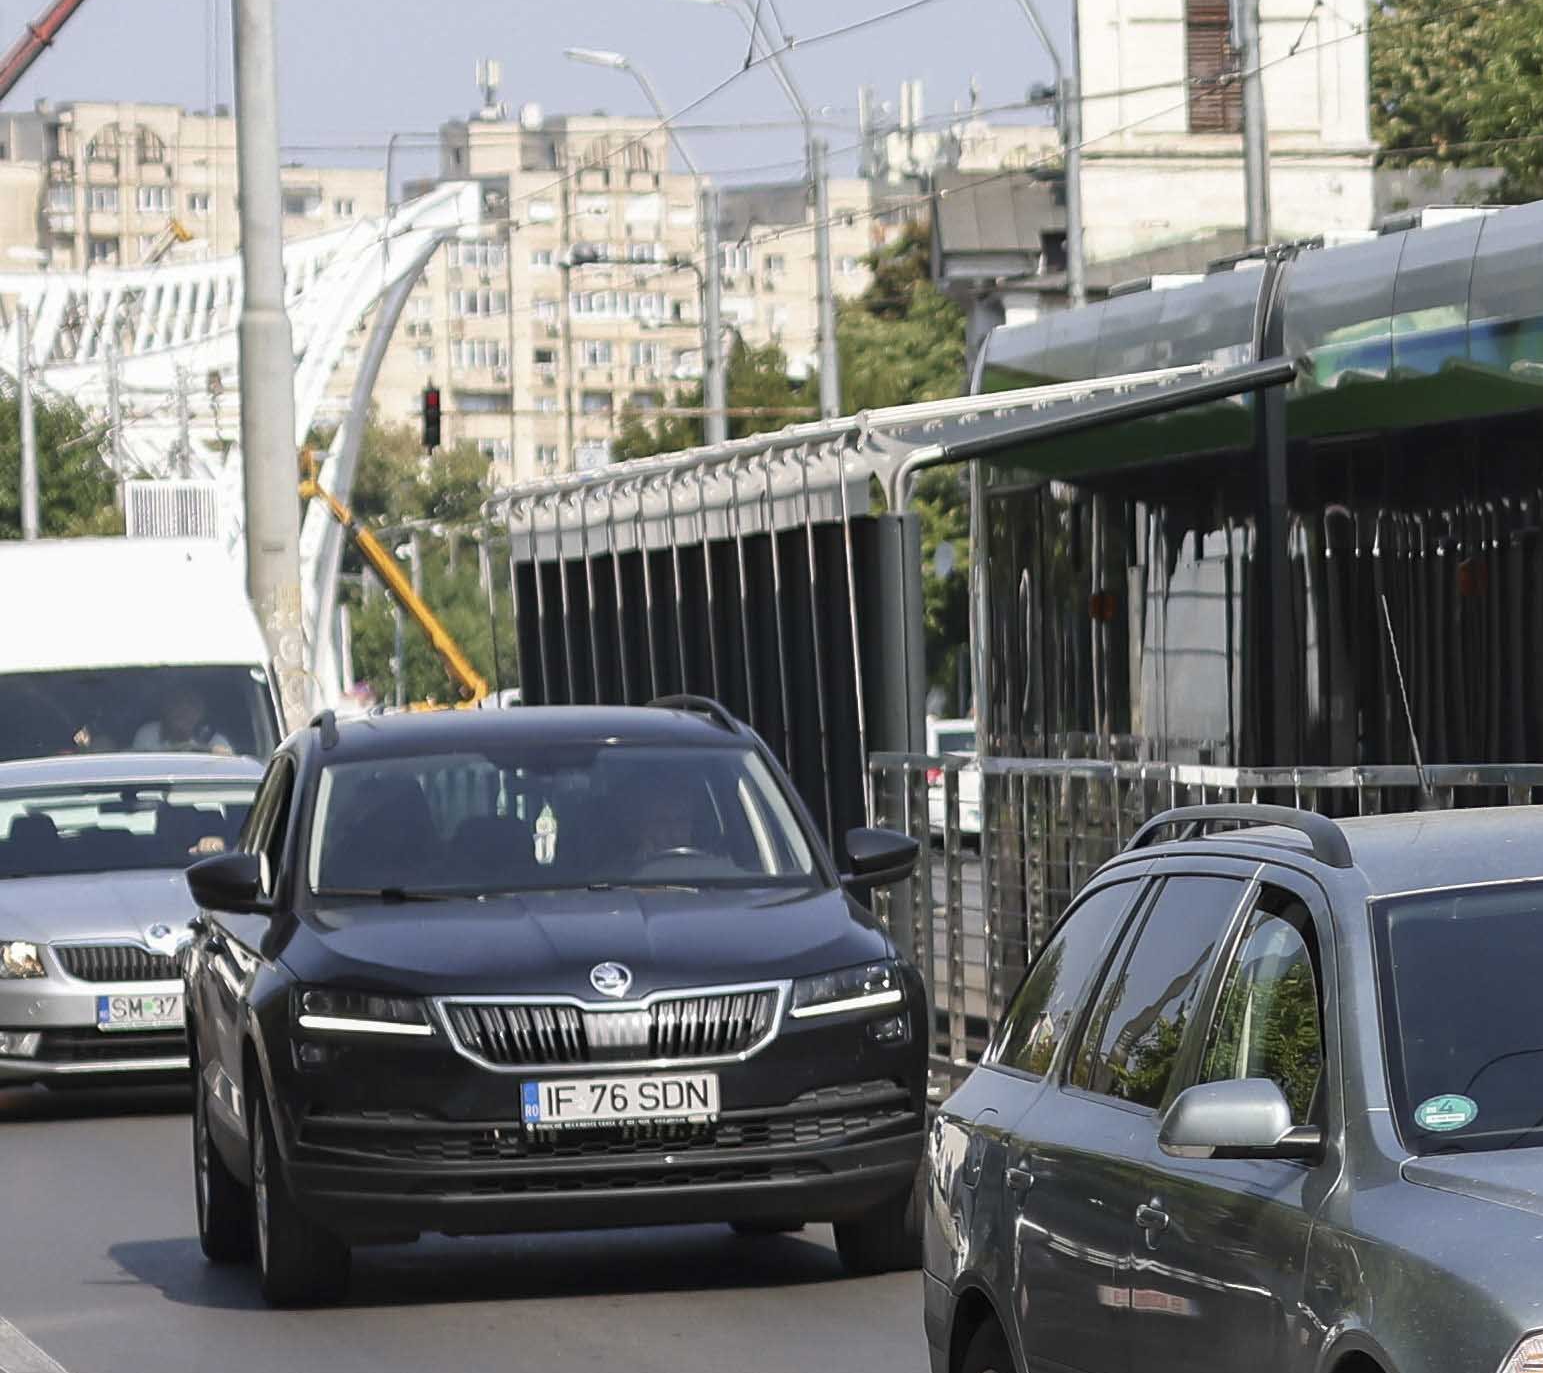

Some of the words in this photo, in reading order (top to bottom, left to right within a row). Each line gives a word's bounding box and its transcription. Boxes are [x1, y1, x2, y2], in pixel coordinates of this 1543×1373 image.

[111, 997, 143, 1019] SM
[547, 1085, 576, 1117] IF
[589, 1082, 629, 1114] 76
[638, 1079, 709, 1111] SDN
[525, 1103, 539, 1117] RO
